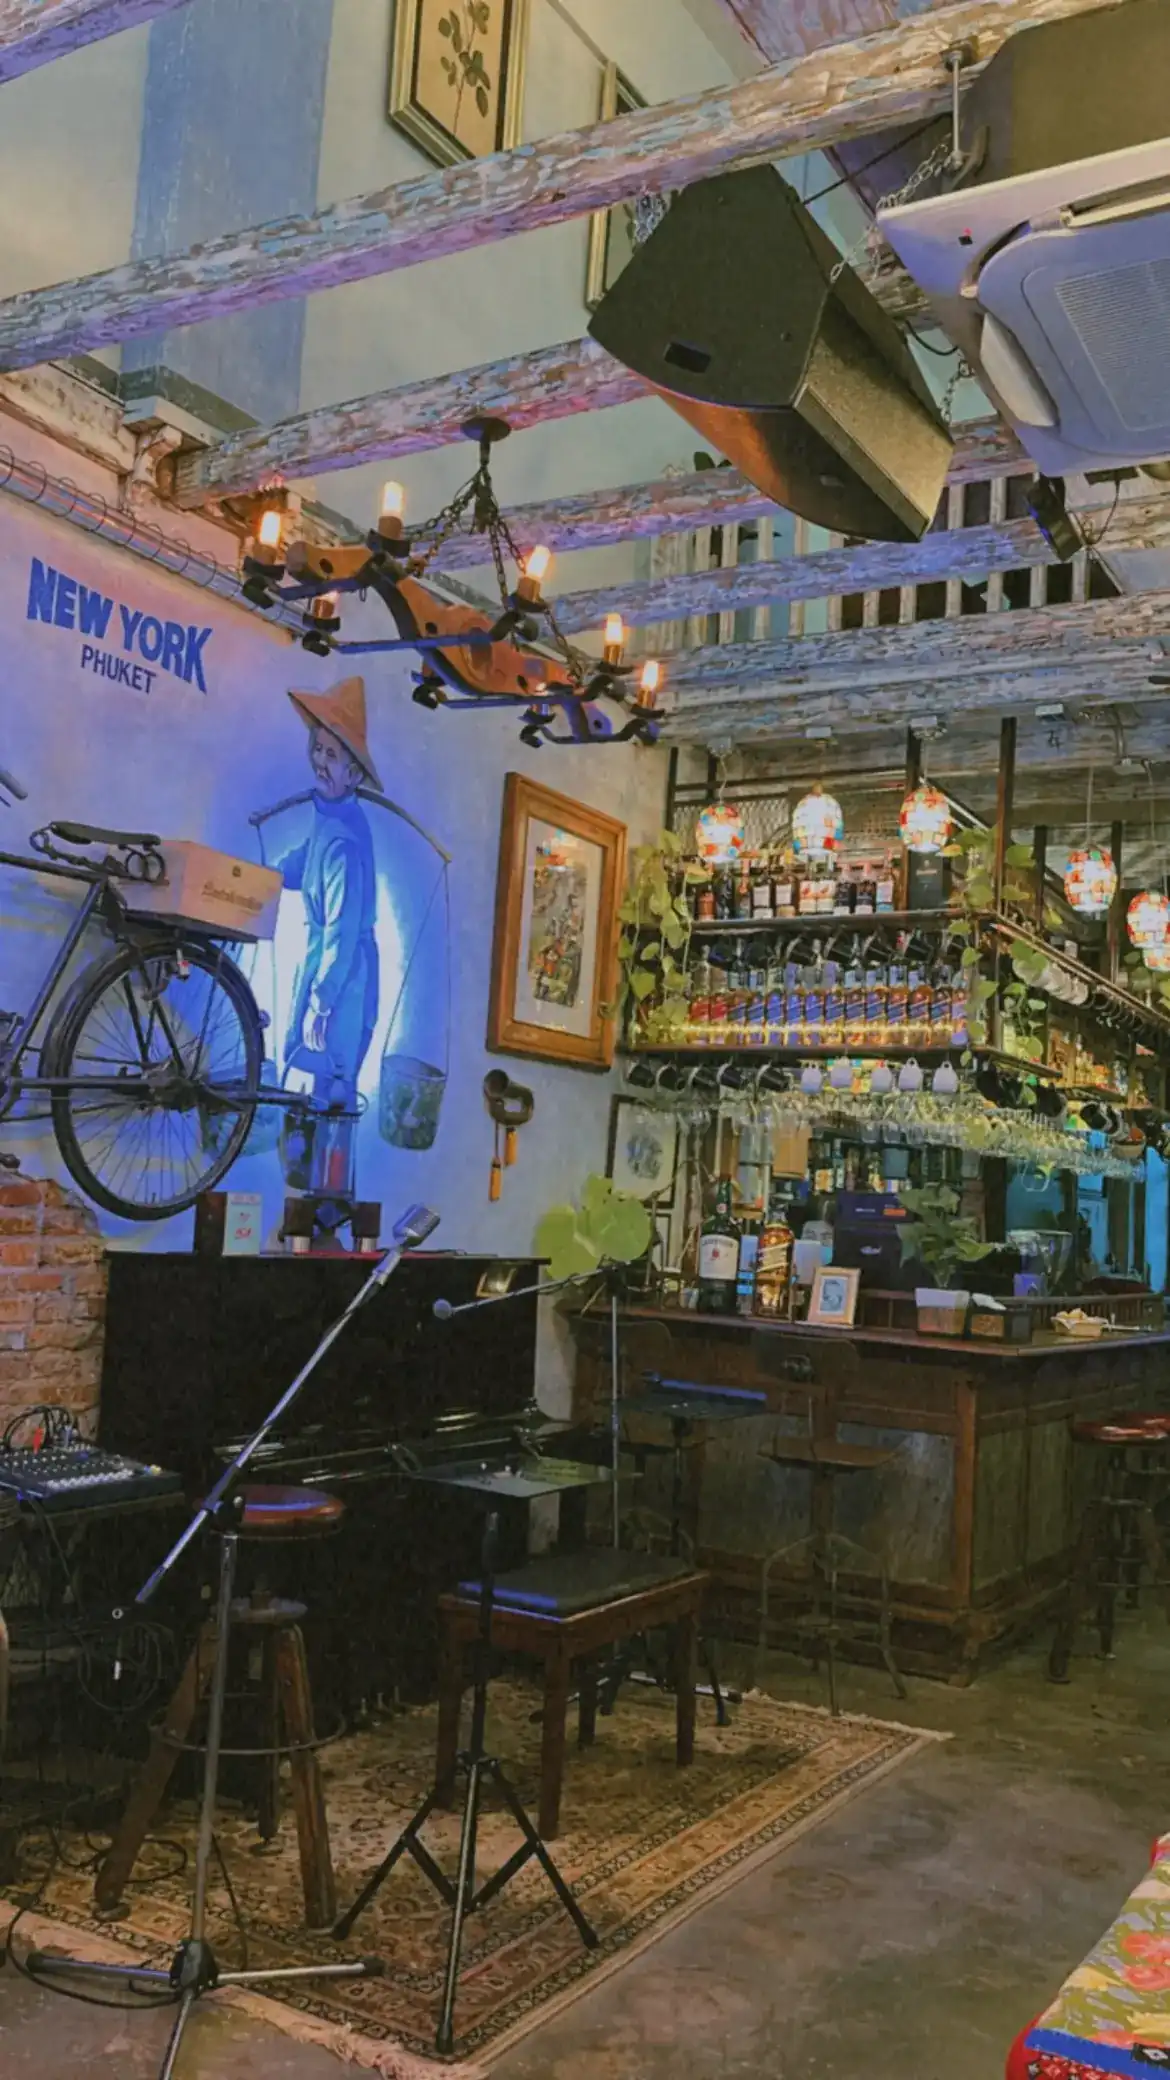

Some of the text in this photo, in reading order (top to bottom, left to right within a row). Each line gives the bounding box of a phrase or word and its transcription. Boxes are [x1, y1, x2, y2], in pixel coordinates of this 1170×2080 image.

[27, 557, 213, 695] NEW YORK
[80, 644, 157, 694] PHUKET
